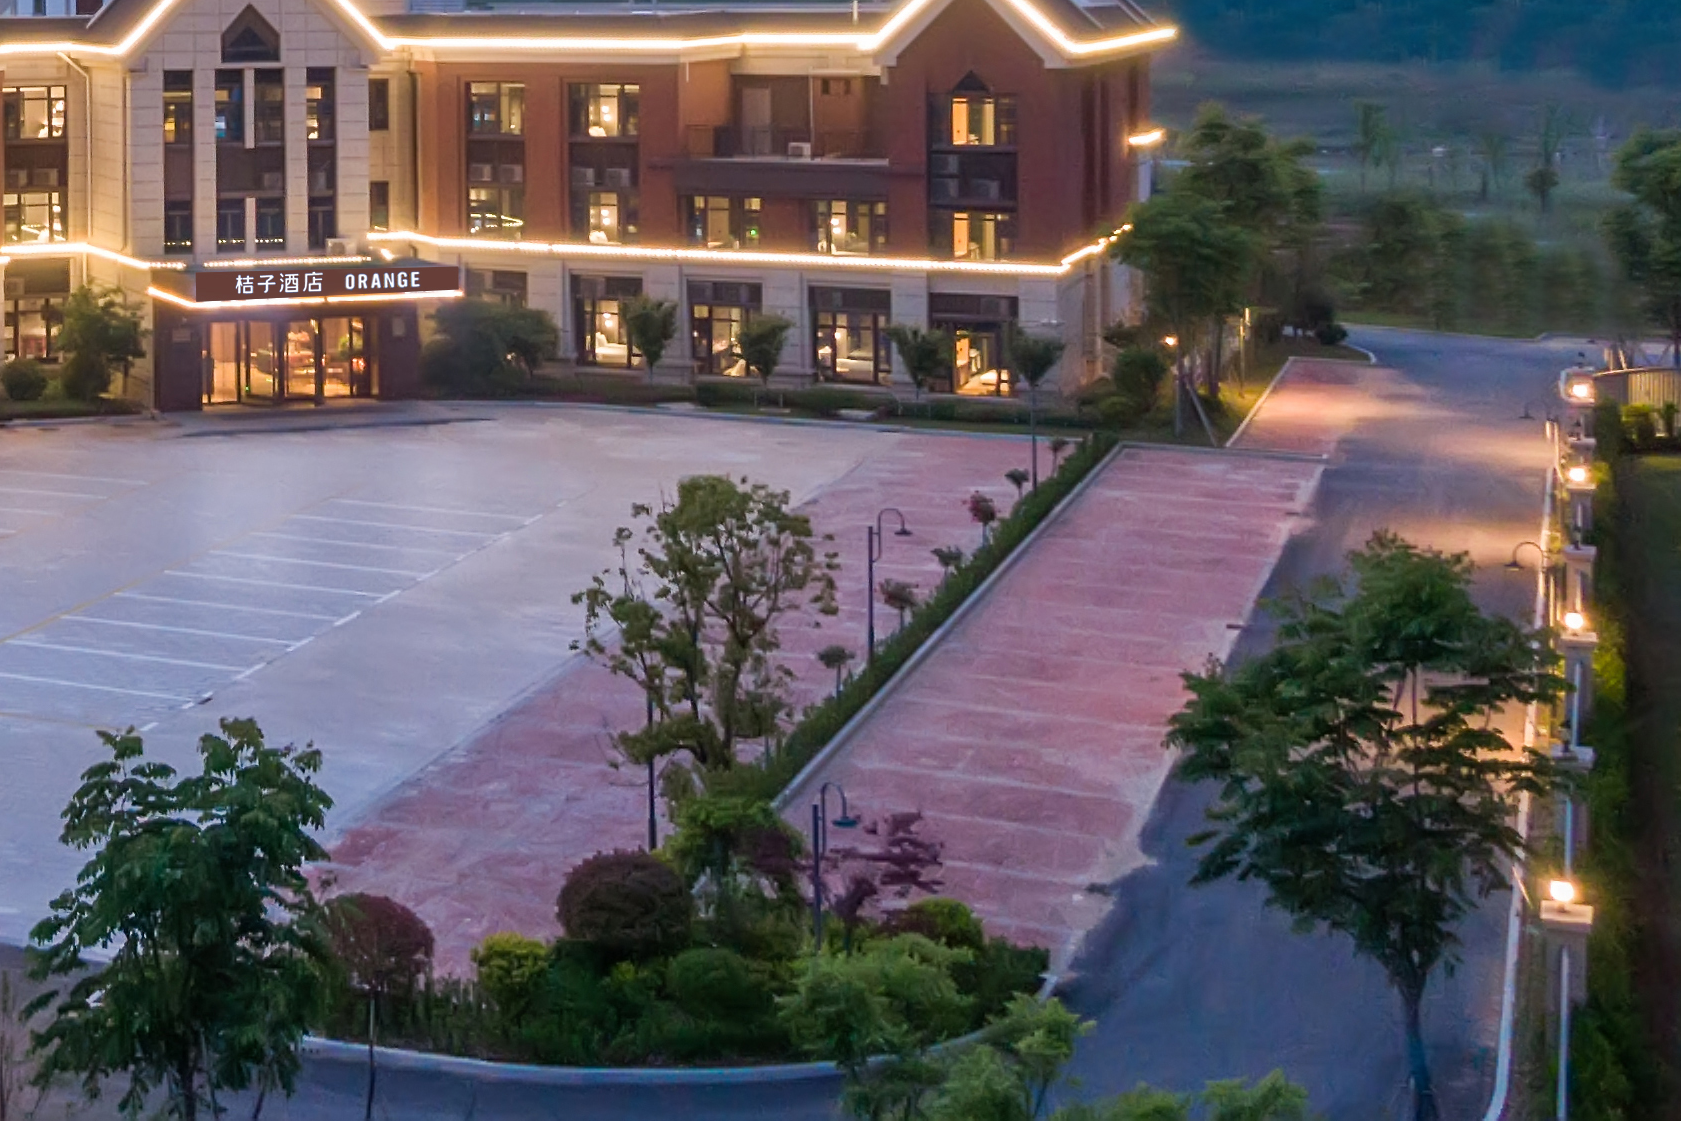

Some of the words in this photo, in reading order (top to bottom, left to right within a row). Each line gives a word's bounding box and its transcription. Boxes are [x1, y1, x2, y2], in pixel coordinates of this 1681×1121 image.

[236, 271, 324, 294] 桔子酒店
[344, 271, 421, 291] ORANGE
